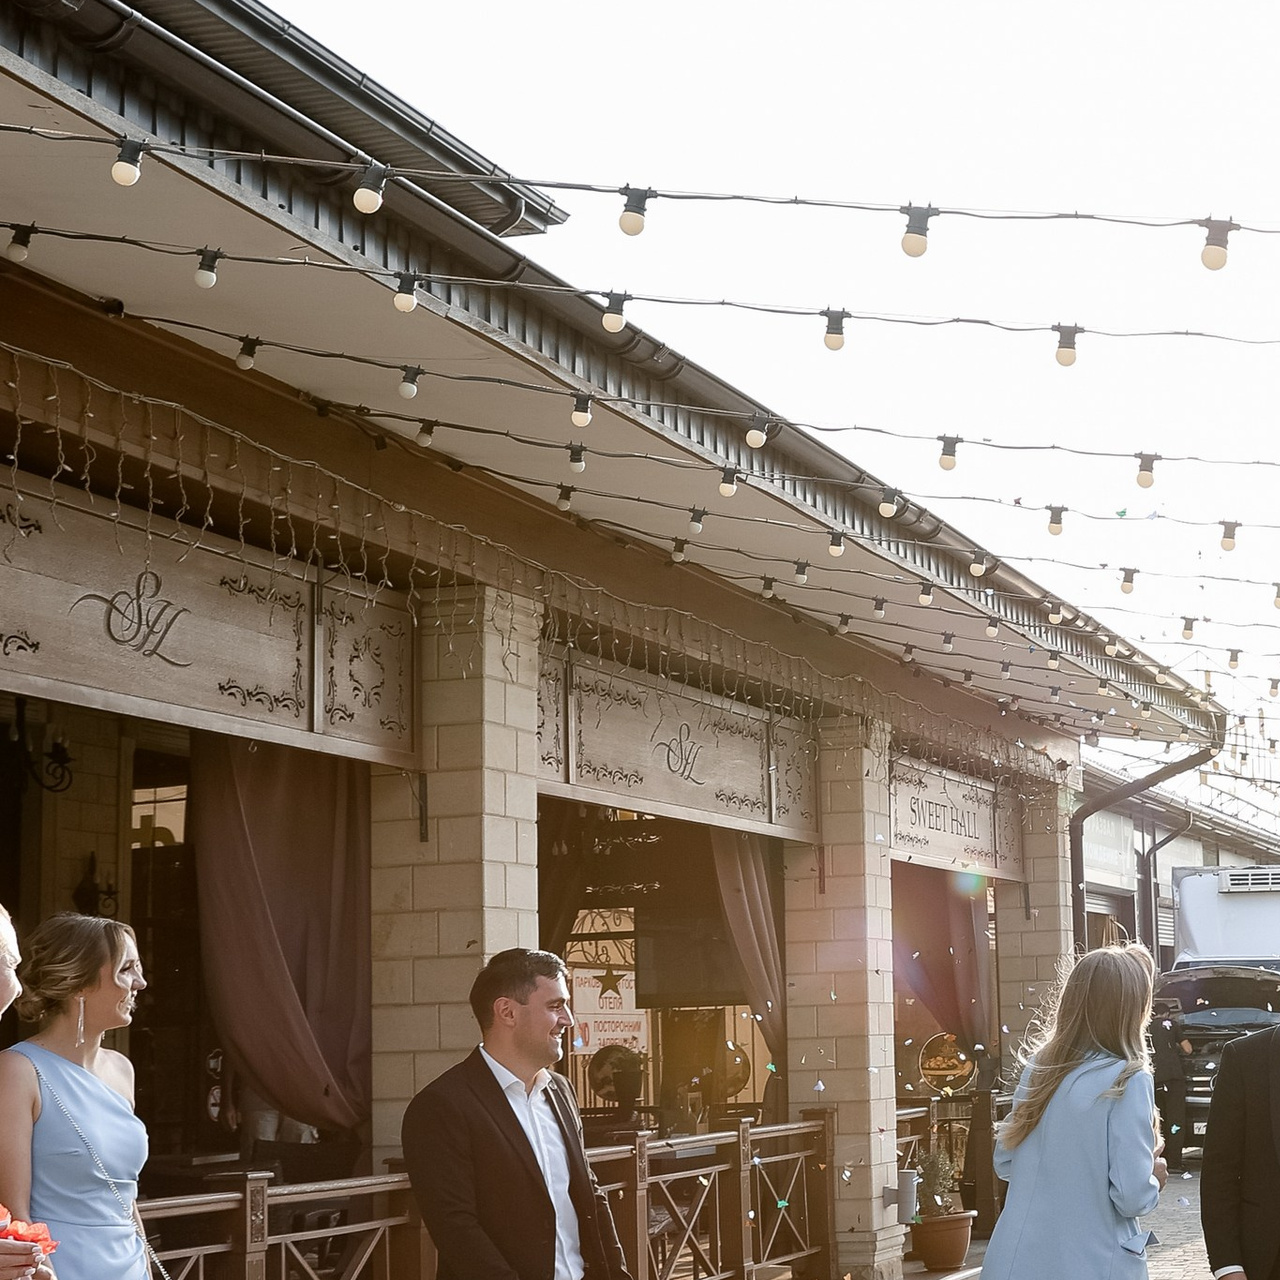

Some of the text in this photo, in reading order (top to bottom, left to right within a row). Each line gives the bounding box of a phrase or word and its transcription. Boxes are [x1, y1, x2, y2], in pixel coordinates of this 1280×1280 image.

[910, 795, 980, 840] SWEET HALL
[598, 996, 623, 1010] ОТЕЛЯ
[594, 1021, 641, 1032] ПОСТОРОННИМ
